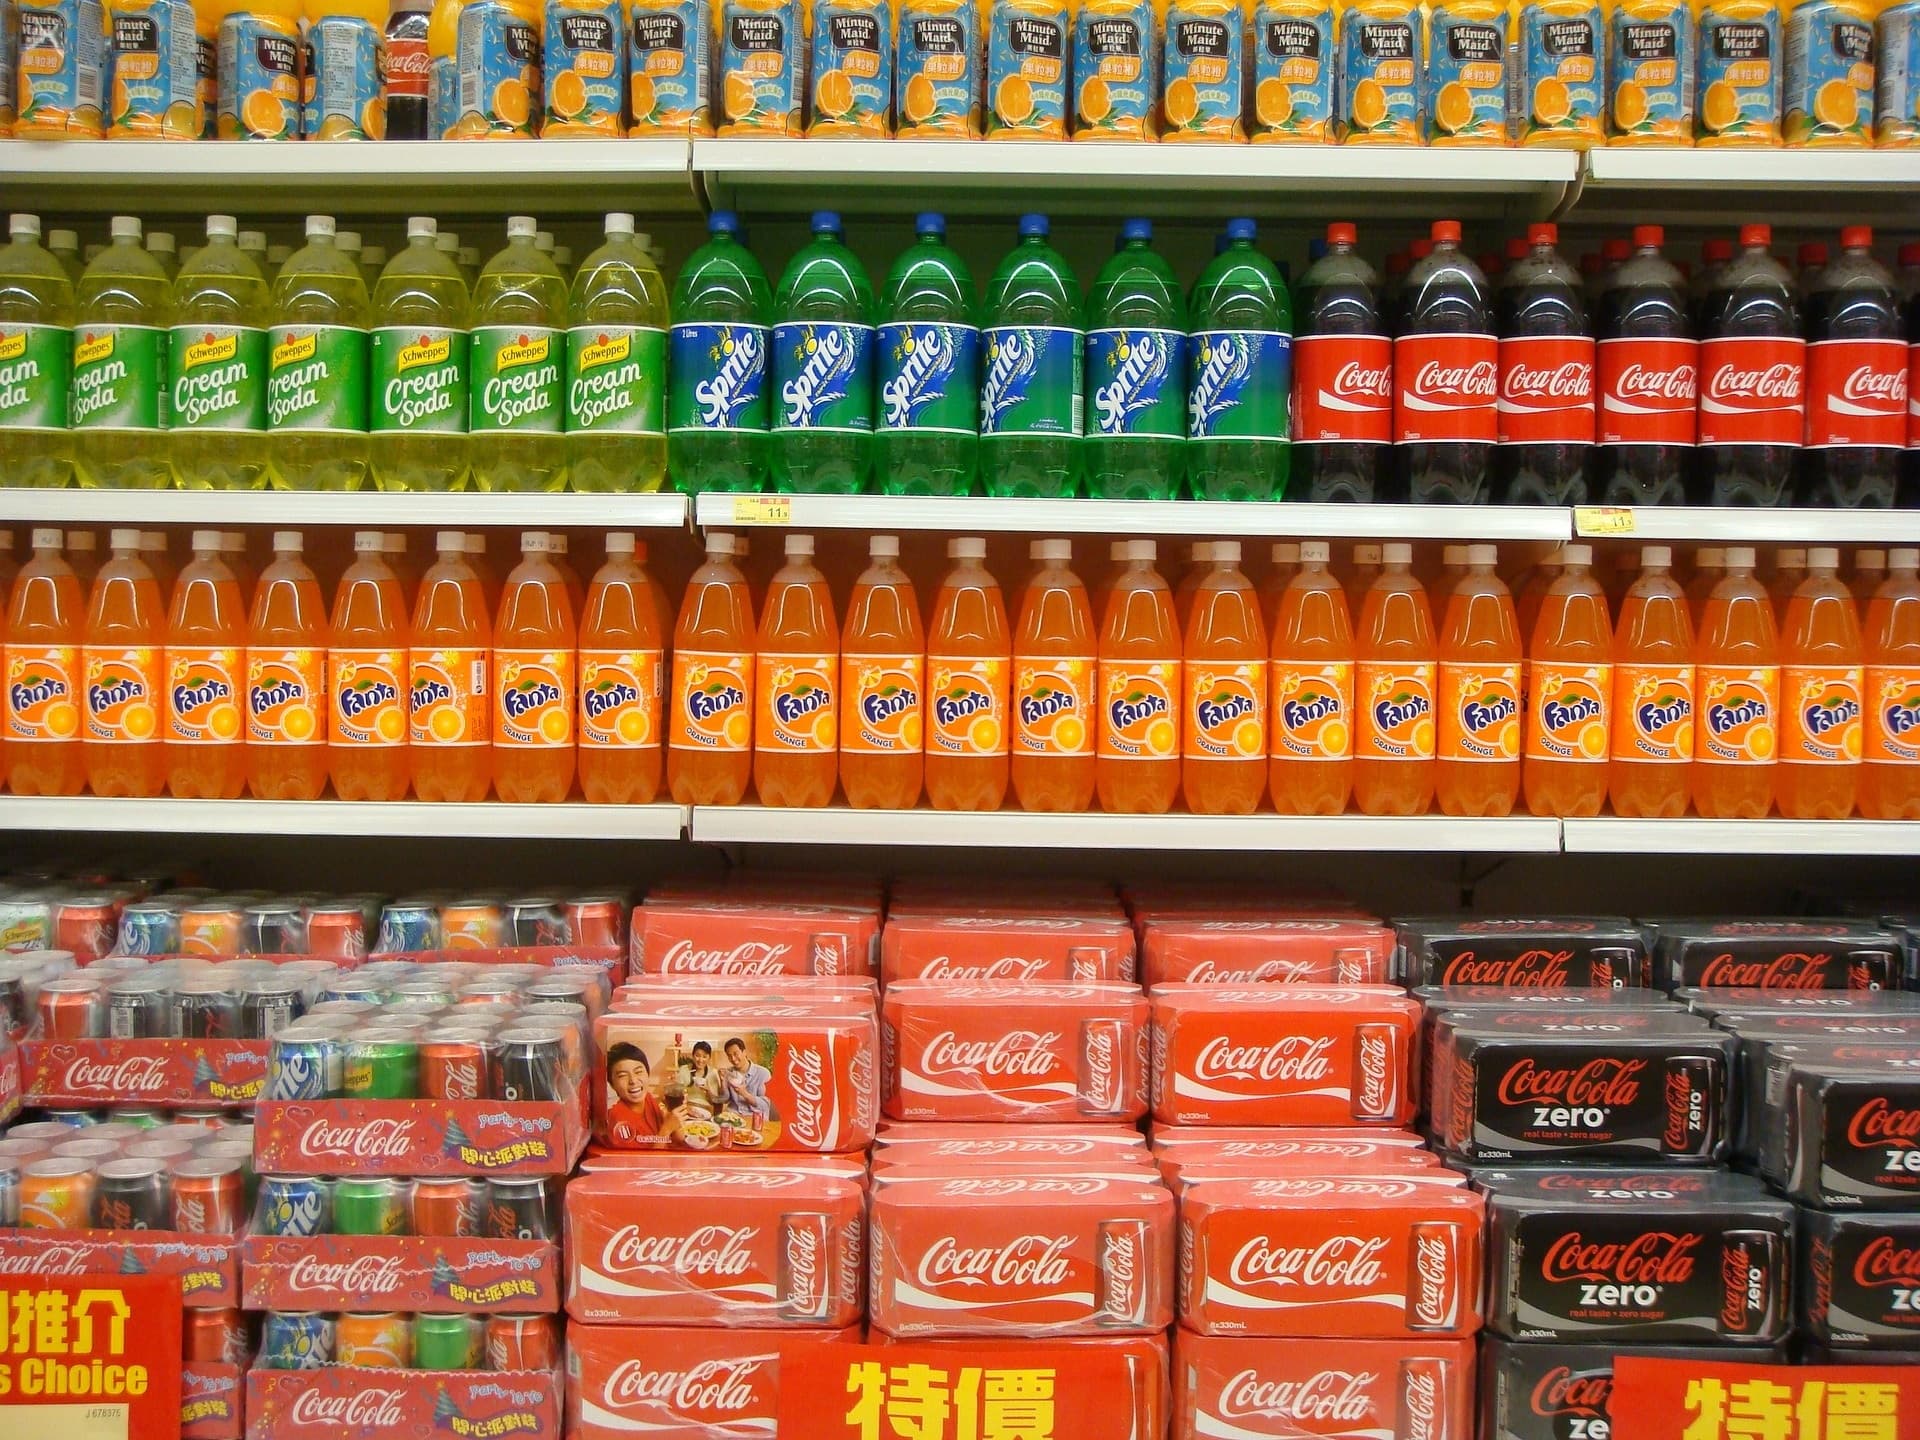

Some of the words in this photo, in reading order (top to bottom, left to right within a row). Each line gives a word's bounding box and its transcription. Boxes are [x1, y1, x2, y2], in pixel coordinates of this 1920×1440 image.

[566, 18, 607, 29] Minute
[571, 28, 602, 40] Maid
[639, 17, 678, 28] Minute
[643, 28, 673, 40] Maid
[738, 18, 779, 30] Minute
[741, 30, 775, 40] Maid
[836, 18, 874, 30] Minute
[841, 28, 871, 40] Maid
[918, 20, 957, 32] Minute
[922, 31, 953, 43] Maid
[1016, 21, 1056, 36] Minute
[1093, 22, 1133, 35] Minute
[1096, 33, 1130, 44] Maid
[1183, 22, 1223, 36] Minute
[1186, 34, 1218, 45] Maid
[1274, 23, 1315, 36] Minute
[1279, 33, 1311, 46] Maid
[1365, 25, 1408, 37] Minute
[1454, 28, 1496, 40] Minute
[1549, 23, 1589, 36] Minute
[1628, 26, 1671, 38] Minute
[1718, 27, 1764, 37] Minute
[1020, 34, 1052, 46] Maid
[1371, 36, 1404, 48] Maid
[1458, 39, 1491, 51] Maid
[1554, 34, 1587, 46] Maid
[1633, 38, 1667, 49] Maid
[1723, 38, 1760, 49] Maid
[189, 342, 234, 361] Schweppes
[274, 343, 312, 362] Schweppes
[402, 346, 447, 365] Schweppes
[502, 346, 546, 364] Schweppes
[584, 343, 626, 364] Schweppes
[74, 360, 127, 395] ream
[175, 361, 248, 414] Cream
[268, 361, 329, 414] Cream
[386, 365, 460, 414] Cream
[484, 364, 558, 414] Cream
[571, 363, 642, 416] Cream
[696, 330, 757, 424] Sprite
[783, 330, 843, 424] Sprite
[884, 330, 942, 424] Sprite
[1095, 336, 1156, 430] Sprite
[1415, 360, 1497, 395] Coca-Cola
[1504, 362, 1591, 398] Coca-Cola
[1710, 363, 1802, 399] Coca-Cola
[10, 679, 65, 711] Fanta
[88, 679, 144, 714] Fanta
[173, 680, 229, 714] Fanta
[250, 680, 302, 714] Fanta
[340, 682, 395, 717] Fanta
[505, 683, 559, 718] Fanta
[583, 683, 637, 719] Fanta
[690, 687, 743, 723] Fanta
[777, 688, 829, 724] Fanta
[864, 688, 917, 725] Fanta
[936, 692, 990, 727] Fanta
[1020, 691, 1074, 724] Fanta
[1111, 695, 1166, 730] Fanta
[1198, 695, 1253, 730] Fanta
[1284, 695, 1339, 730] Fanta
[1376, 696, 1429, 730] Fanta
[1464, 697, 1516, 732] Fanta
[1544, 697, 1599, 732] Fanta
[1639, 697, 1690, 733] Fanta
[1710, 698, 1765, 734] Fanta
[1807, 699, 1859, 734] Fanta
[339, 724, 369, 741] ORANGE
[503, 725, 533, 742] ORANGE
[686, 727, 717, 745] ORANGE
[774, 730, 807, 747] ORANGE
[861, 731, 894, 748] ORANGE
[1196, 737, 1227, 754] ORANGE
[1282, 736, 1312, 754] ORANGE
[1373, 737, 1406, 754] ORANGE
[1462, 740, 1494, 756] ORANGE
[1707, 740, 1739, 759] ORANGE
[920, 1031, 1061, 1076] Coca-Cola
[1087, 1023, 1112, 1110] Coca-Cola
[1195, 1036, 1337, 1079] Coca-Cola
[66, 1057, 169, 1091] Coca-Cola
[1360, 1032, 1385, 1114] Coca-Cola
[1498, 1058, 1648, 1105] Coca-Cola
[788, 1045, 824, 1148] Coca-Cola
[1664, 1071, 1691, 1150] Coca-Cola
[1689, 1091, 1702, 1131] zero
[1532, 1107, 1604, 1128] zero
[300, 1119, 415, 1157] Coca-Cola
[1589, 1188, 1673, 1199] zero
[602, 1224, 760, 1275] Coca-Cola
[918, 1235, 1078, 1287] Coca-Cola
[1230, 1236, 1392, 1286] Coca-Cola
[1542, 1232, 1704, 1282] Coca-Cola
[290, 1254, 403, 1292] Coca-Cola
[785, 1225, 818, 1314] Coca-Cola
[1104, 1230, 1135, 1322] Coca-Cola
[1416, 1234, 1447, 1324] Coca-Cola
[1579, 1284, 1658, 1306] zero
[1748, 1268, 1762, 1310] zero
[0, 1290, 130, 1354] 推介
[1210, 1322, 1247, 1330] 8x330mL
[1520, 1330, 1556, 1338] 8x330mL
[30, 1358, 148, 1396] Choice
[603, 1360, 762, 1410] Coca-Cola
[294, 1388, 406, 1426] Coca-Cola
[846, 1361, 1056, 1440] 特價
[1218, 1369, 1380, 1421] Coca-Cola
